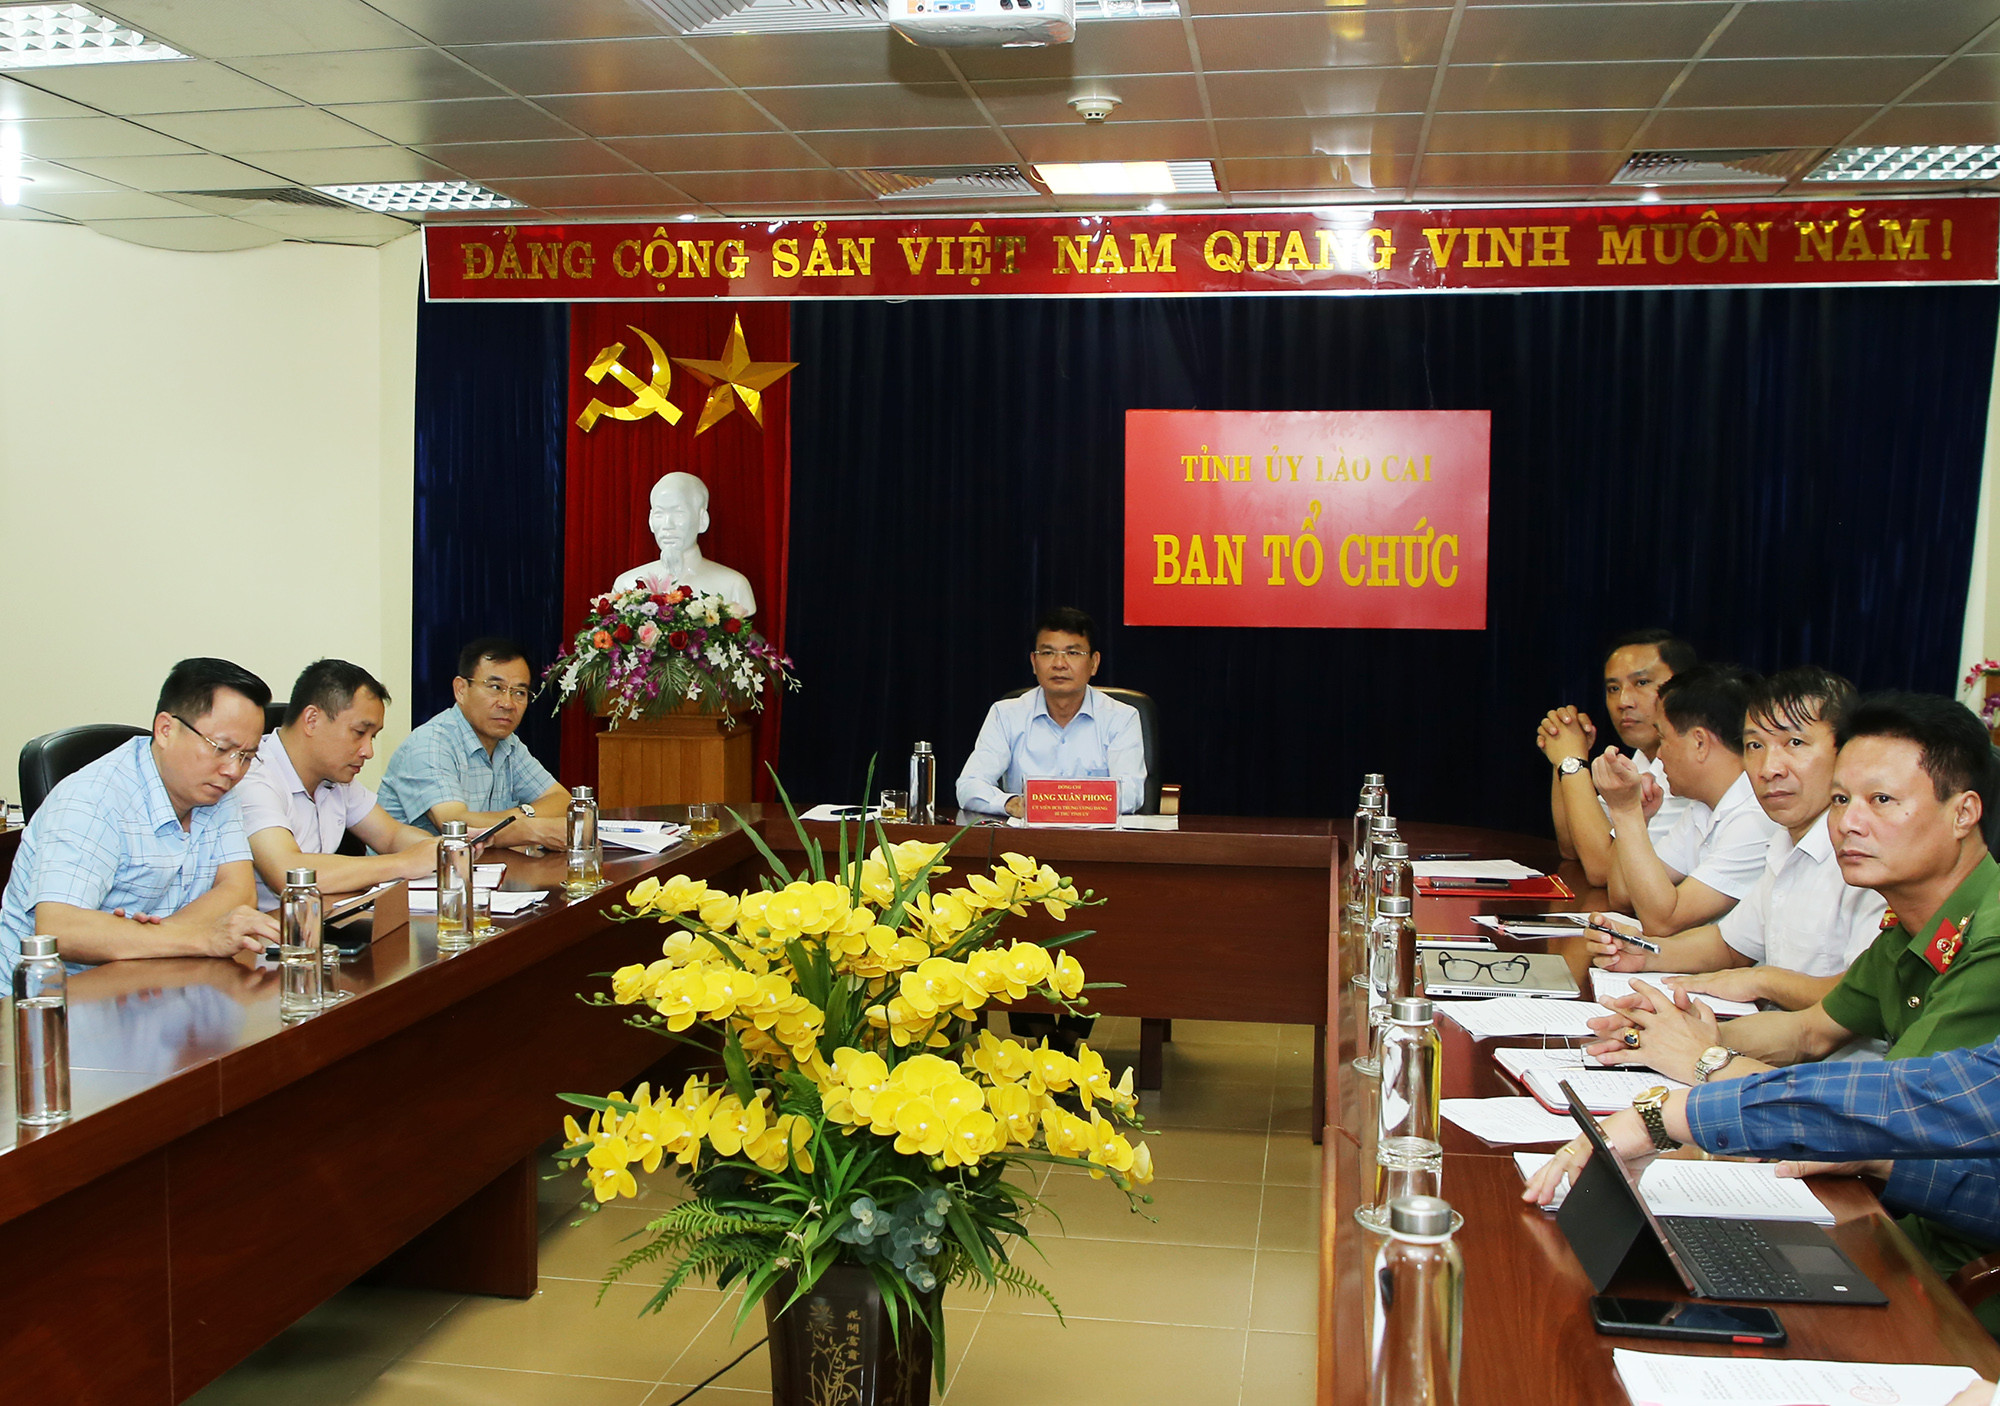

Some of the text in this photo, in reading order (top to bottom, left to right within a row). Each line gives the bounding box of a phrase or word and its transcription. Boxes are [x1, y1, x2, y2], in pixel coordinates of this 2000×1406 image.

[461, 224, 597, 280] ĐẢNG
[612, 226, 752, 291] CỘNG
[771, 221, 876, 279] SẢN
[897, 222, 1027, 286] VIỆT
[1052, 232, 1178, 275] NAM
[1203, 228, 1398, 274] QUANG
[1421, 226, 1571, 269] VINH
[1596, 208, 1774, 266] MUÔN
[1181, 444, 1433, 483] TỈNH ỦY LÀO CAI
[1153, 499, 1459, 588] BAN TỔ CHỨC
[1057, 792, 1081, 801] XUÂN
[1082, 794, 1112, 802] PHONG
